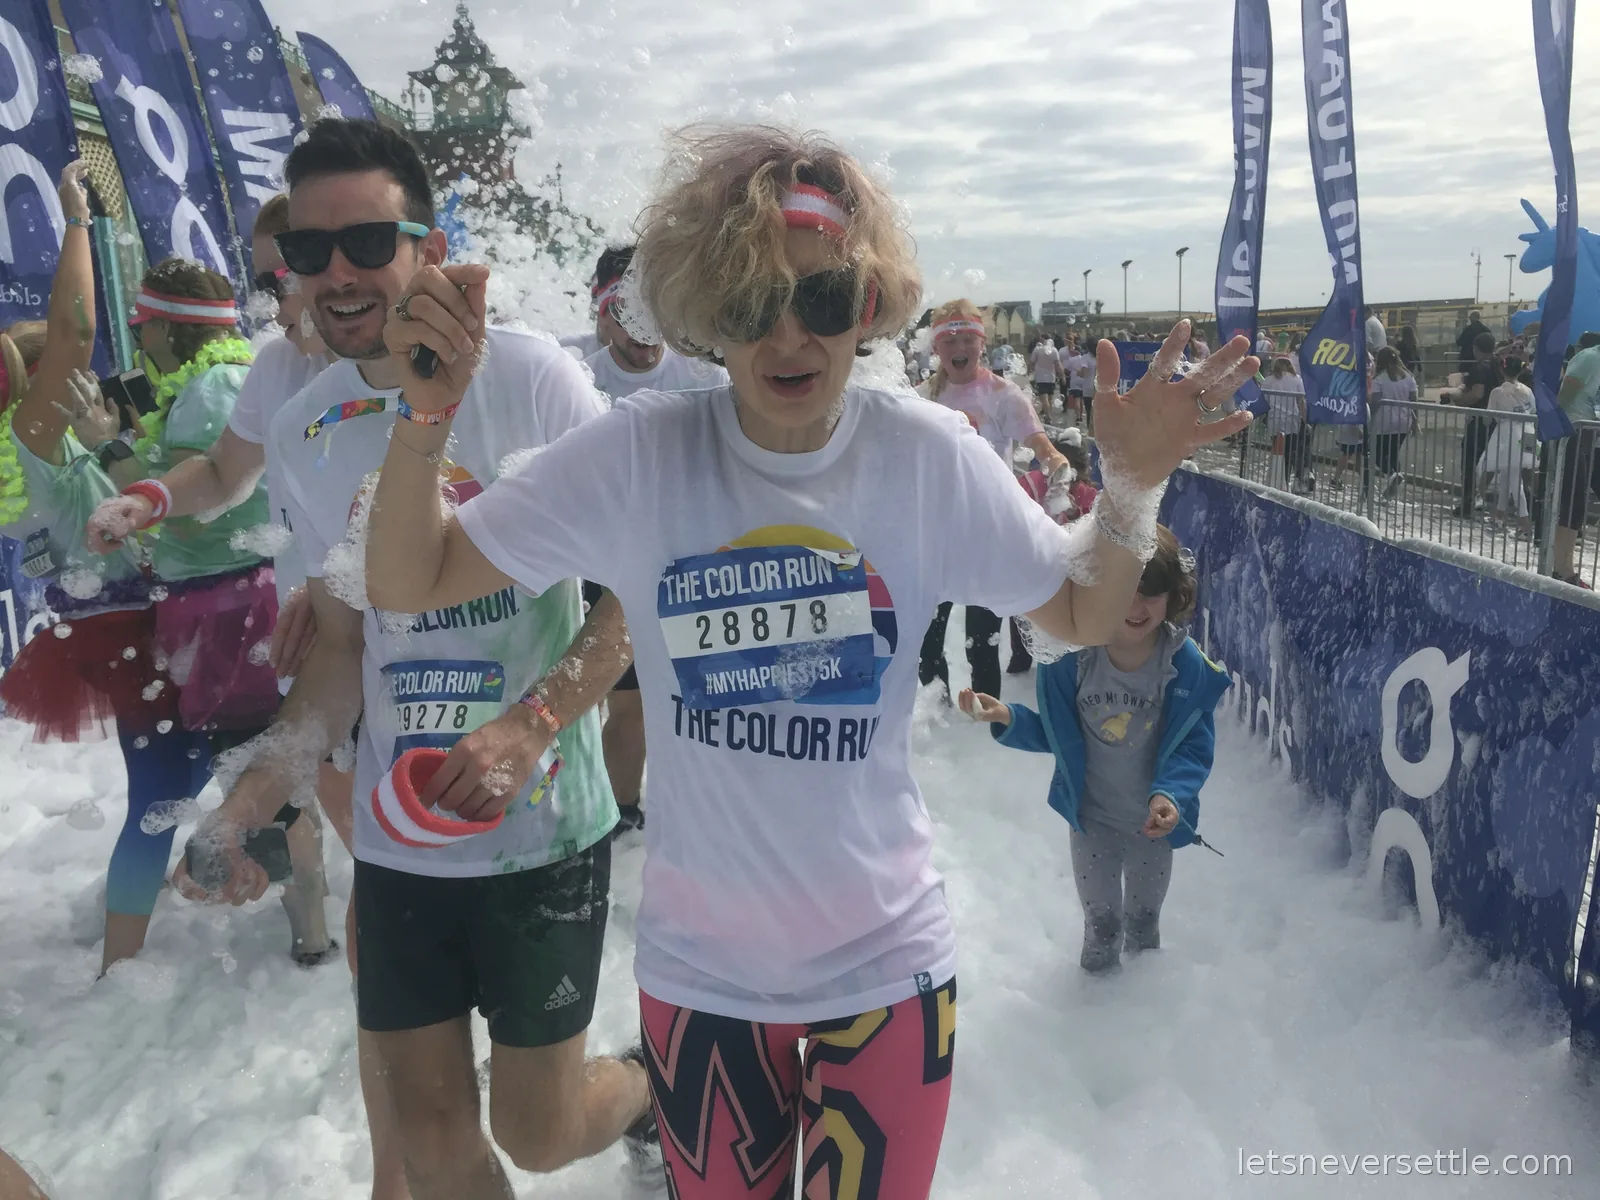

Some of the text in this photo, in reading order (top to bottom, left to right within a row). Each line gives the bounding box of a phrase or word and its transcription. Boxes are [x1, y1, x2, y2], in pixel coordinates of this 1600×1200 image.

[662, 556, 834, 605] THE COLOR RUN
[696, 599, 828, 650] 28878
[398, 670, 445, 696] COLOR
[445, 670, 483, 694] RUN
[671, 694, 720, 748] THE
[726, 708, 831, 761] COLOR
[544, 991, 581, 1011] adidas
